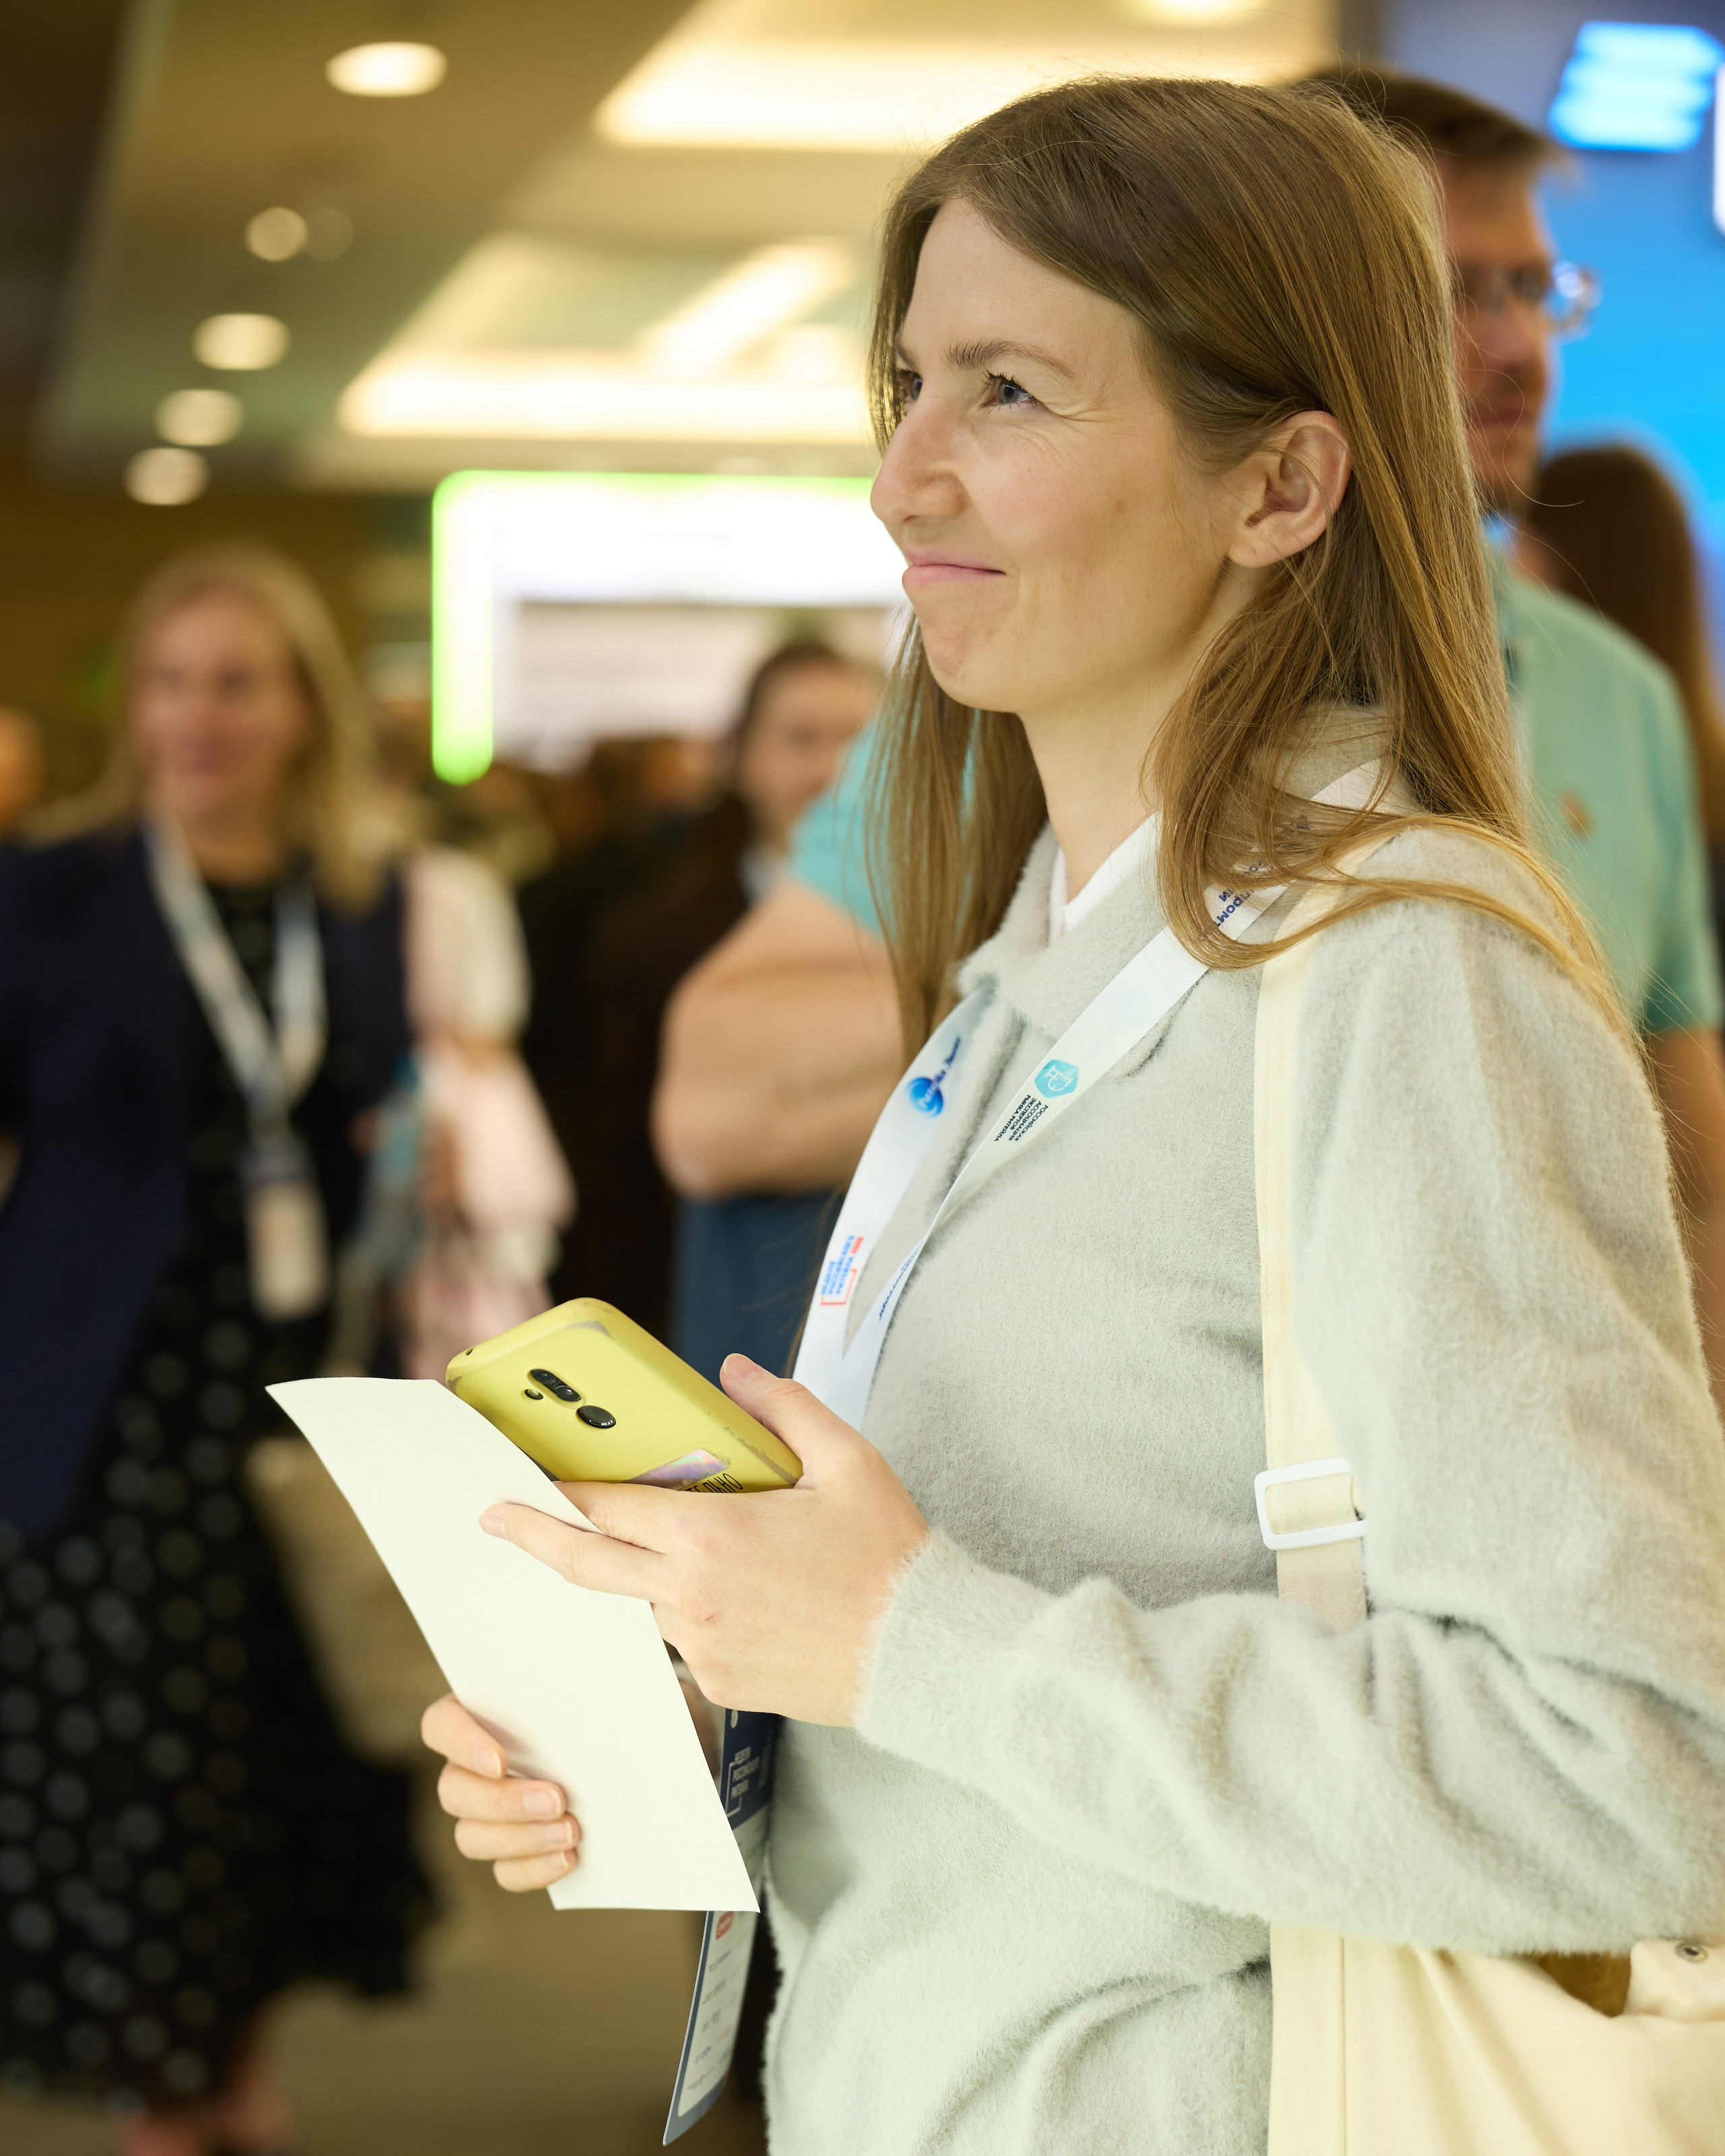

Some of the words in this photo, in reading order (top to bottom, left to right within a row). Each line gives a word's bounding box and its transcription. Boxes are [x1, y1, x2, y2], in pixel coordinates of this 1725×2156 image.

[1010, 1098, 1037, 1130] ЭКСПЕРТОВ
[1014, 1095, 1031, 1114] РЫНКА
[994, 1115, 1015, 1141] РИТЕЙЛА
[1008, 1101, 1042, 1141] АССОЦИАЦИЯ
[1014, 1105, 1048, 1141] РОССИЙСКАЯ
